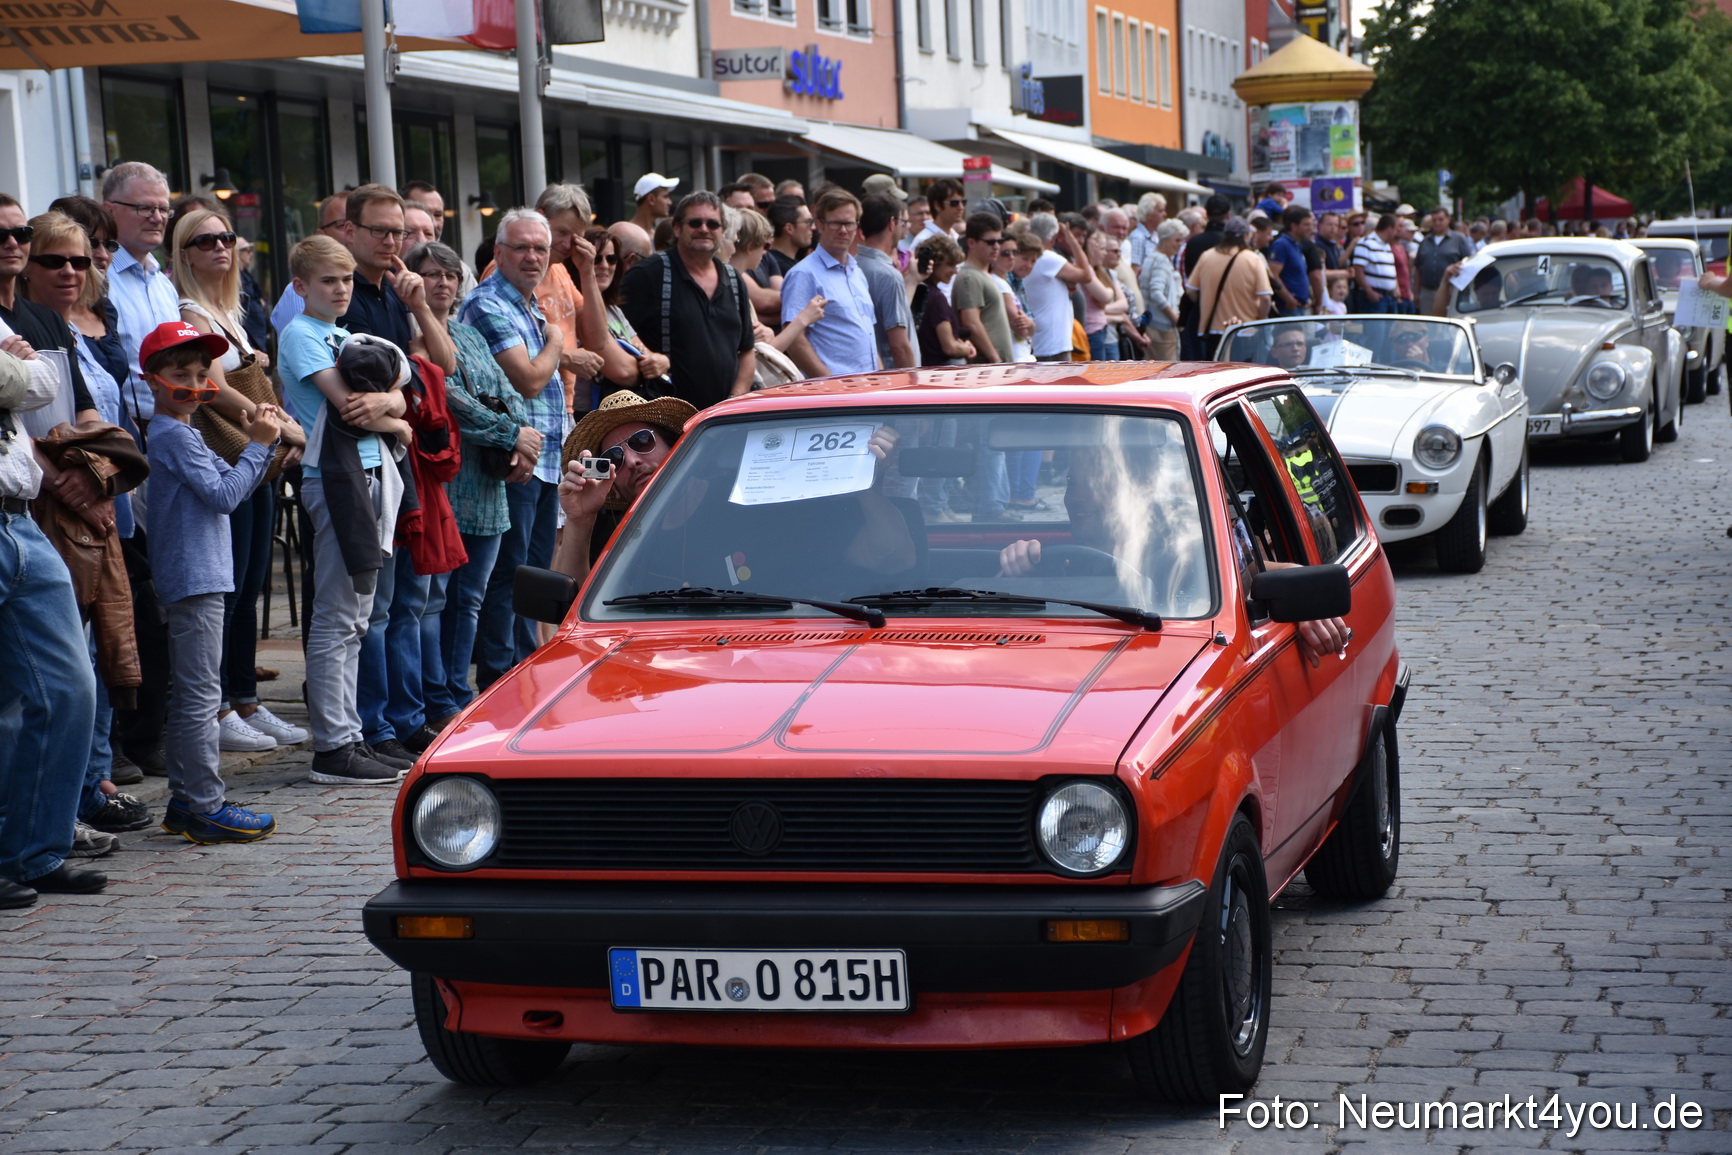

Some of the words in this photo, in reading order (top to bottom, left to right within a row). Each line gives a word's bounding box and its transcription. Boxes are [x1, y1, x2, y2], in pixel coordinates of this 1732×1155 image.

[1539, 257, 1549, 273] 4
[807, 431, 857, 452] 262
[640, 957, 722, 1002] PAR
[793, 958, 901, 1002] 815H
[622, 983, 632, 997] D
